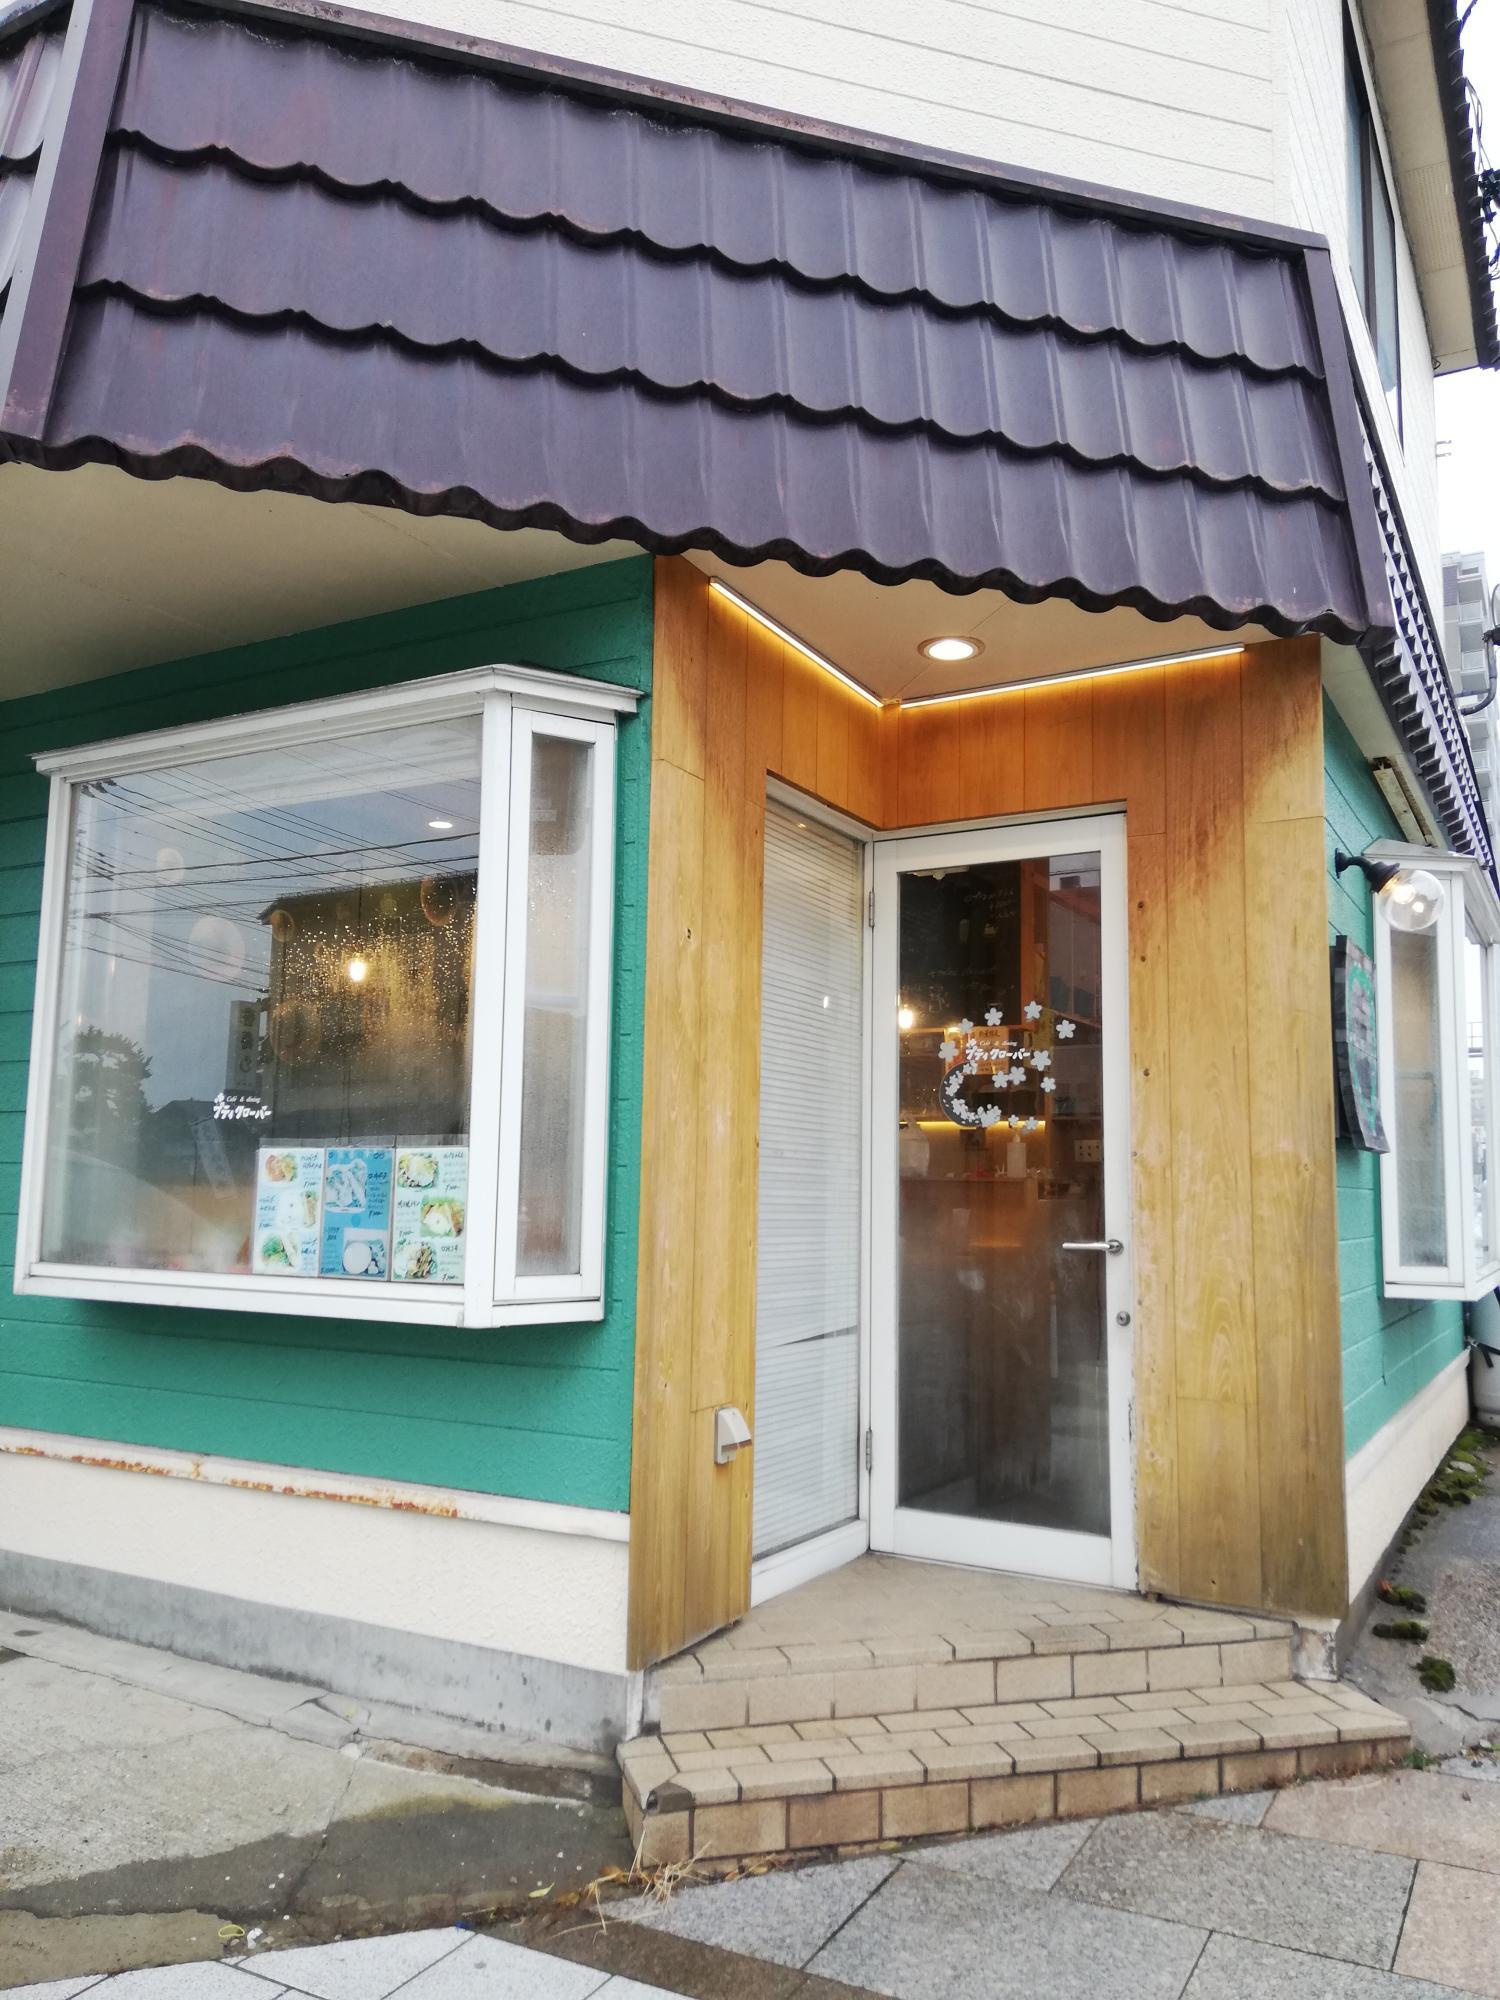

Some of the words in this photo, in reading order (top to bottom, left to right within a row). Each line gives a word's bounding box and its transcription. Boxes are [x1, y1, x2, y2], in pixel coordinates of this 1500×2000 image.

[966, 1046, 1030, 1060] プティクローバー
[213, 1102, 272, 1120] プティクローバー
